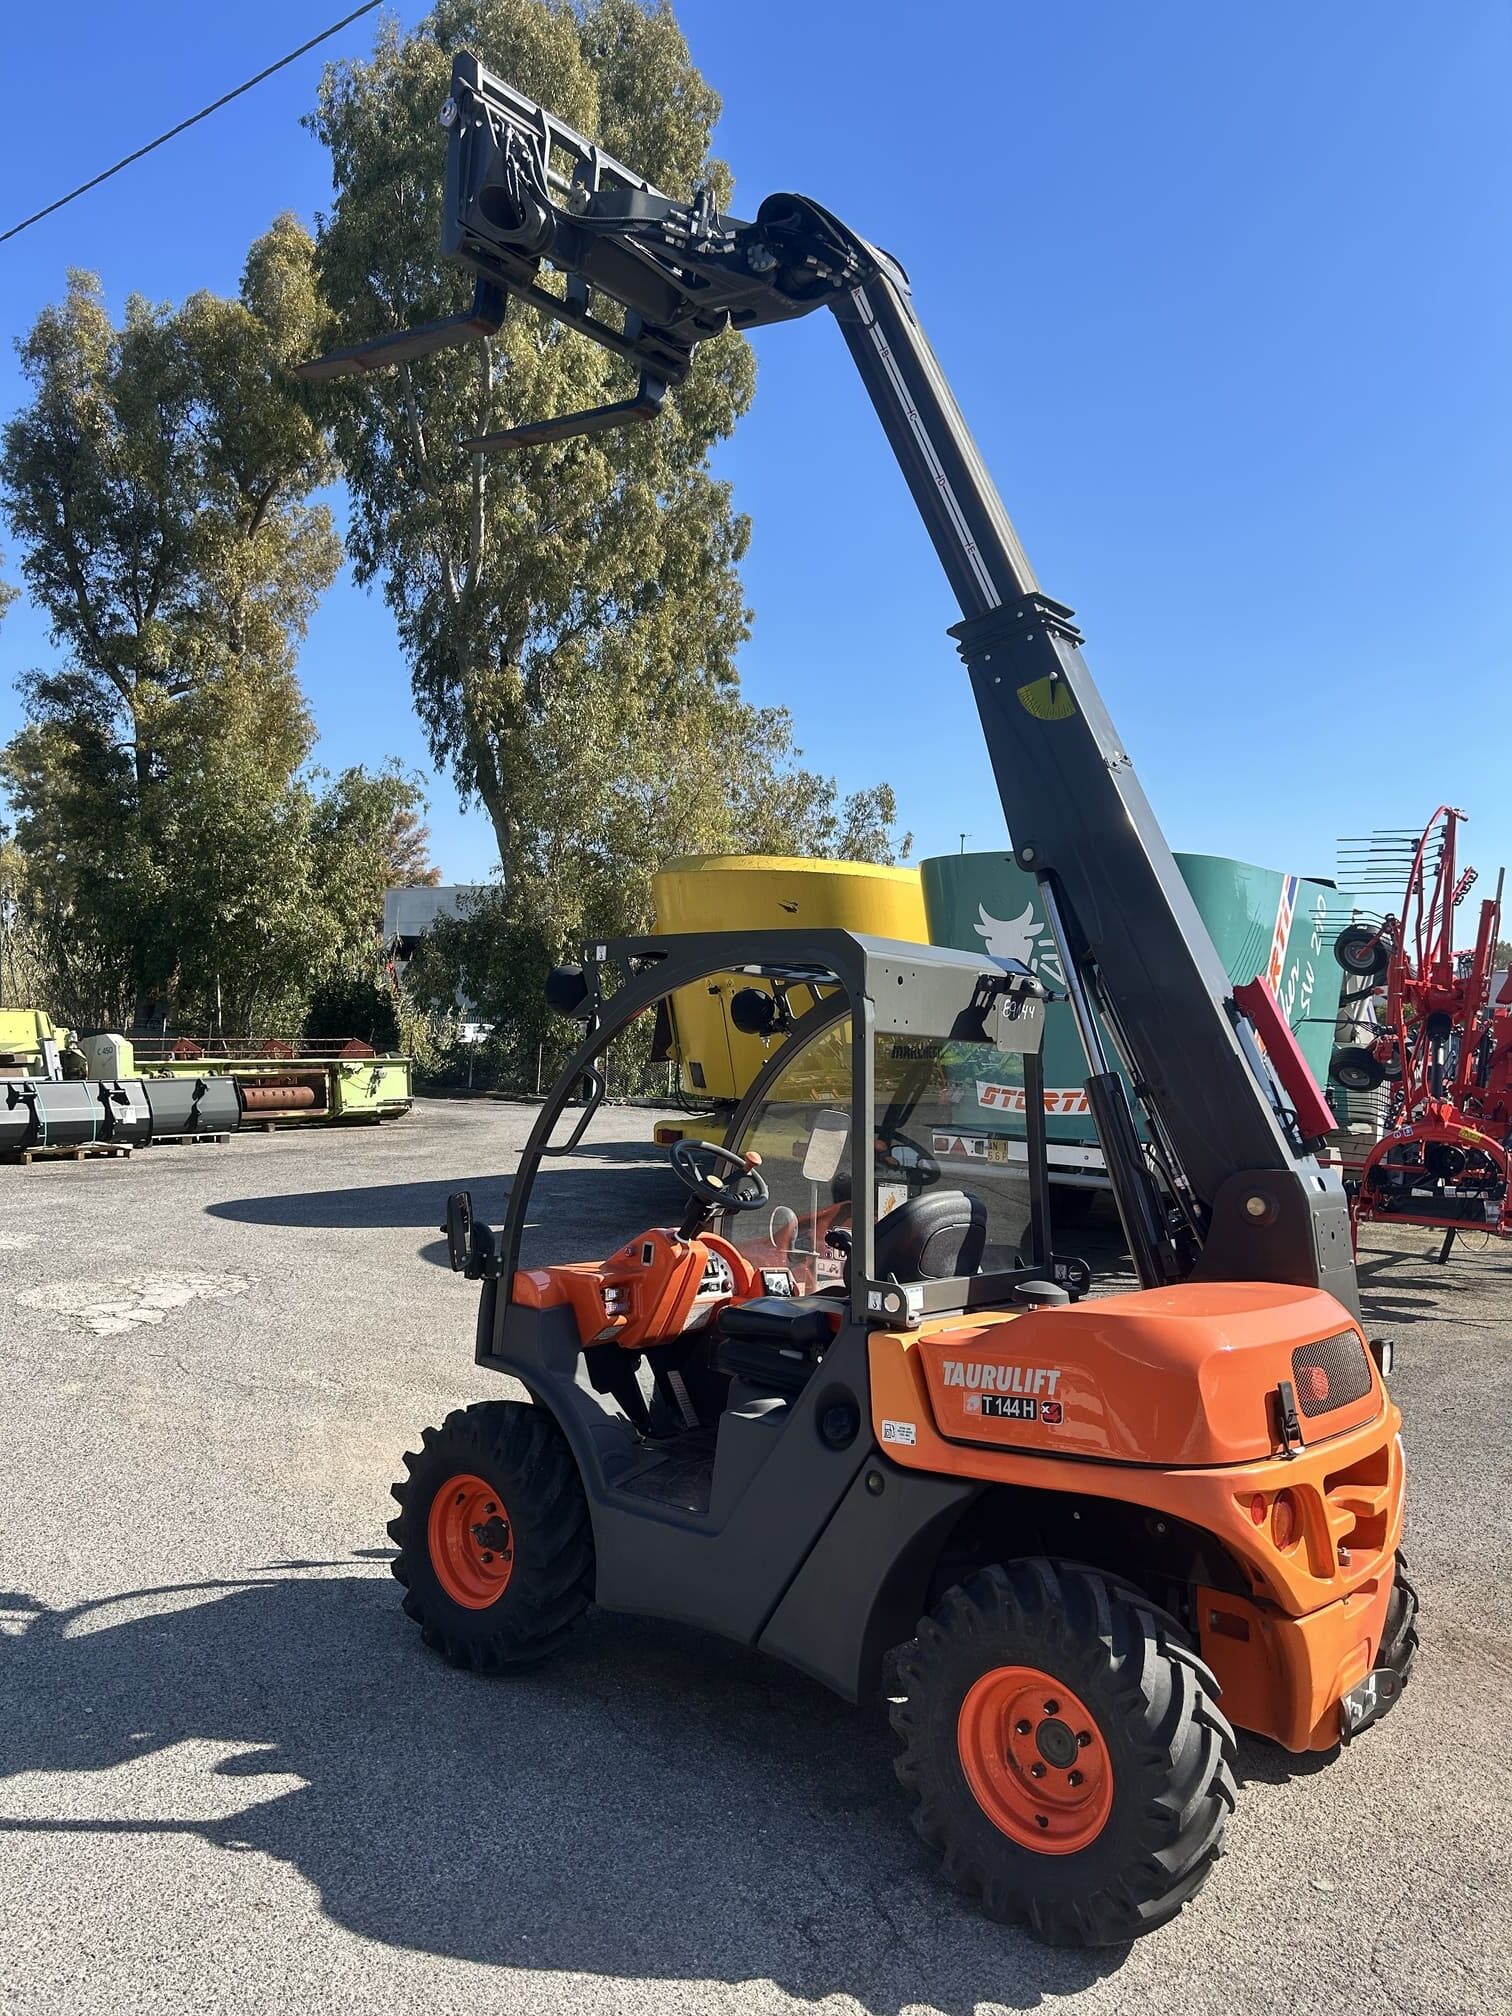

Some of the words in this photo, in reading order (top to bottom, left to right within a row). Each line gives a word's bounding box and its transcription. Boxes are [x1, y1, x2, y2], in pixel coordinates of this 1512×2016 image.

[943, 1361, 1062, 1396] TAURULIFT
[982, 1396, 993, 1414] T
[995, 1398, 1021, 1417] 144
[1023, 1400, 1035, 1419] H
